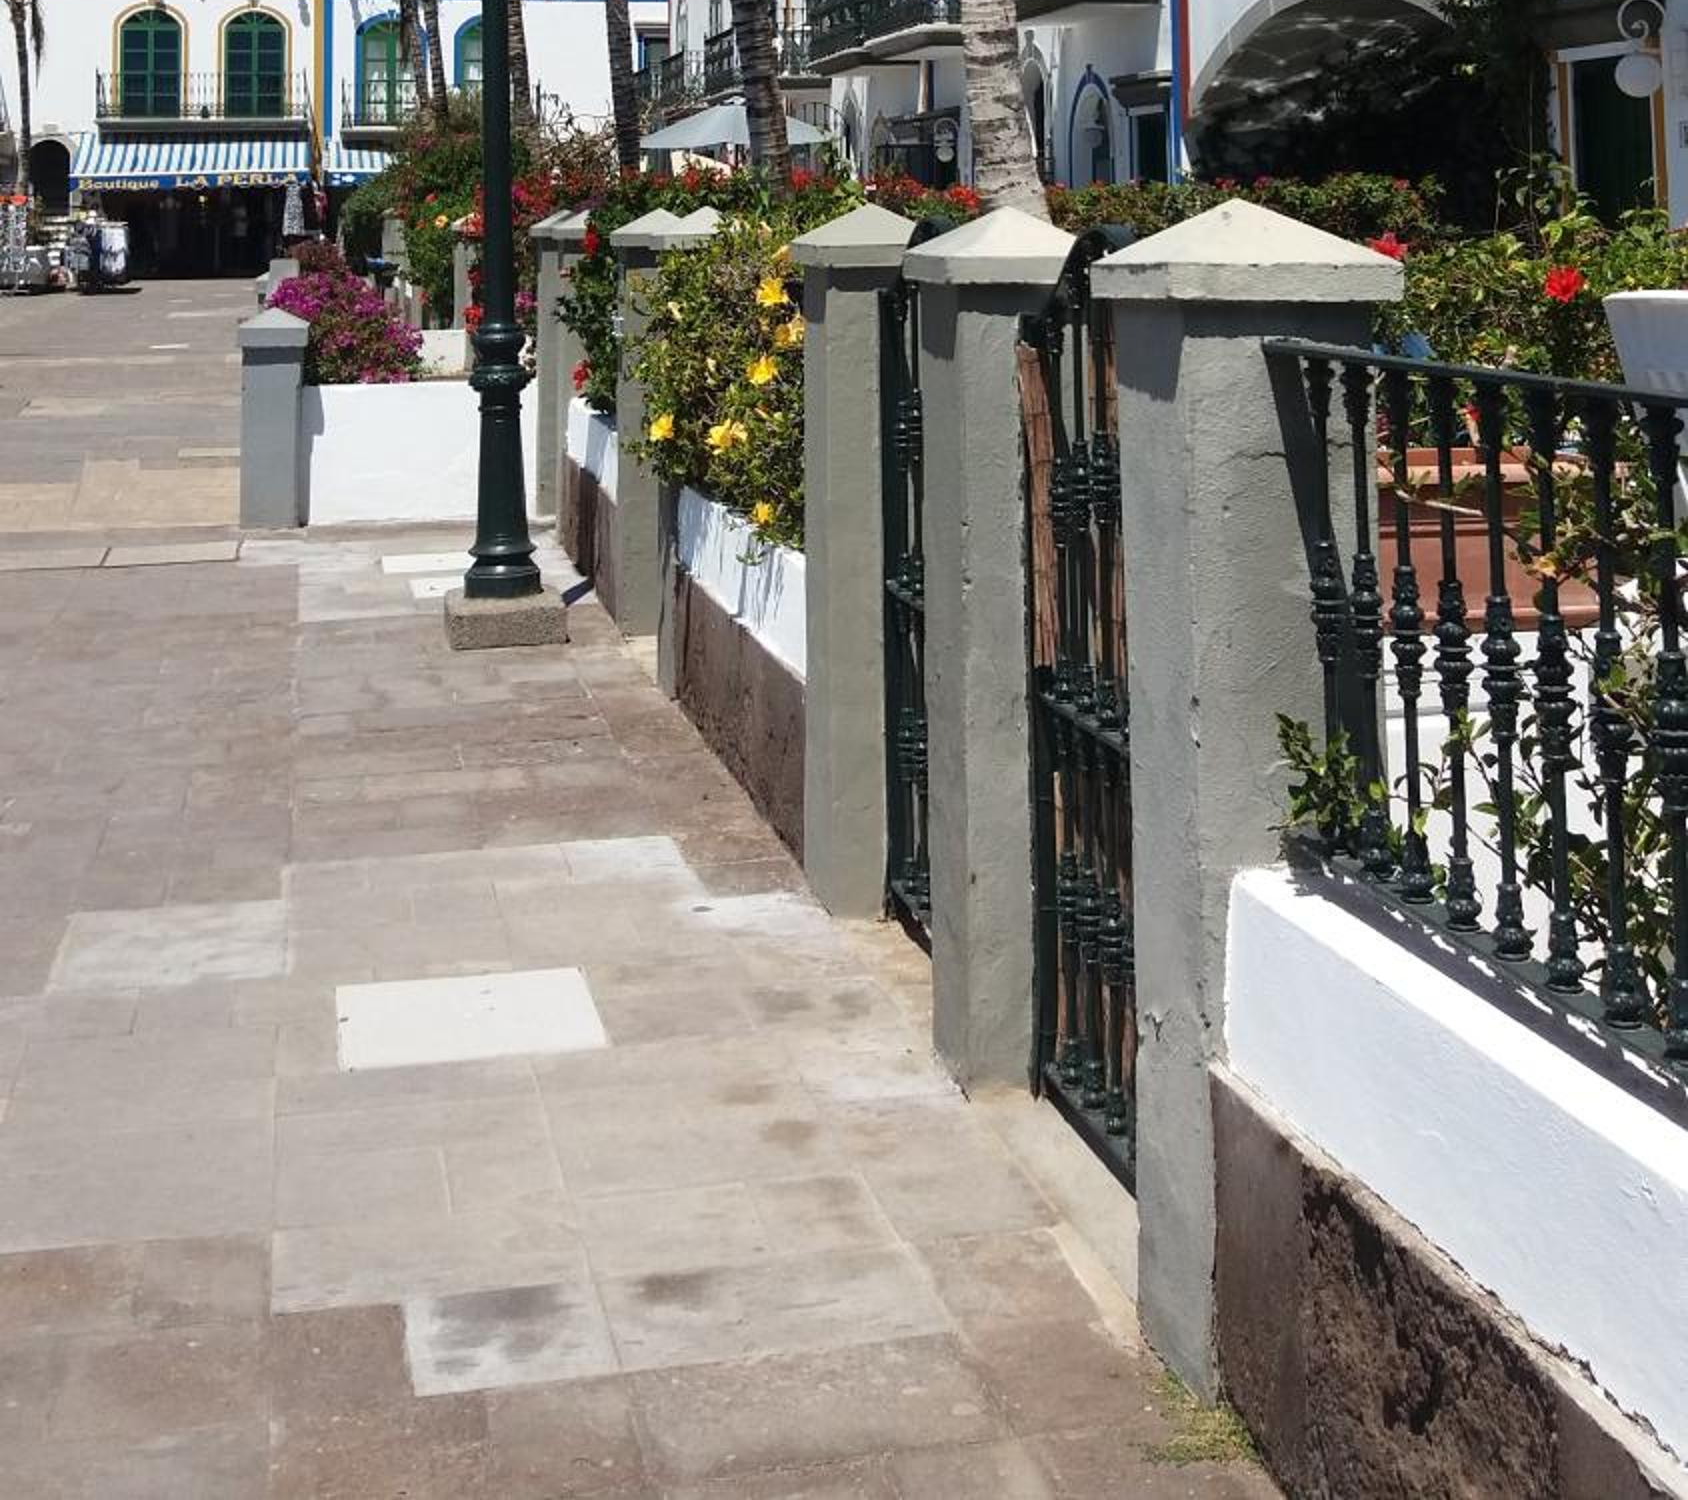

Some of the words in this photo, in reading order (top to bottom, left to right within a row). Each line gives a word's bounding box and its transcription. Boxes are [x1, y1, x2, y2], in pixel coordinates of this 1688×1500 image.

[79, 178, 160, 191] Boutique
[175, 175, 208, 189] LA
[217, 171, 298, 187] PERLA
